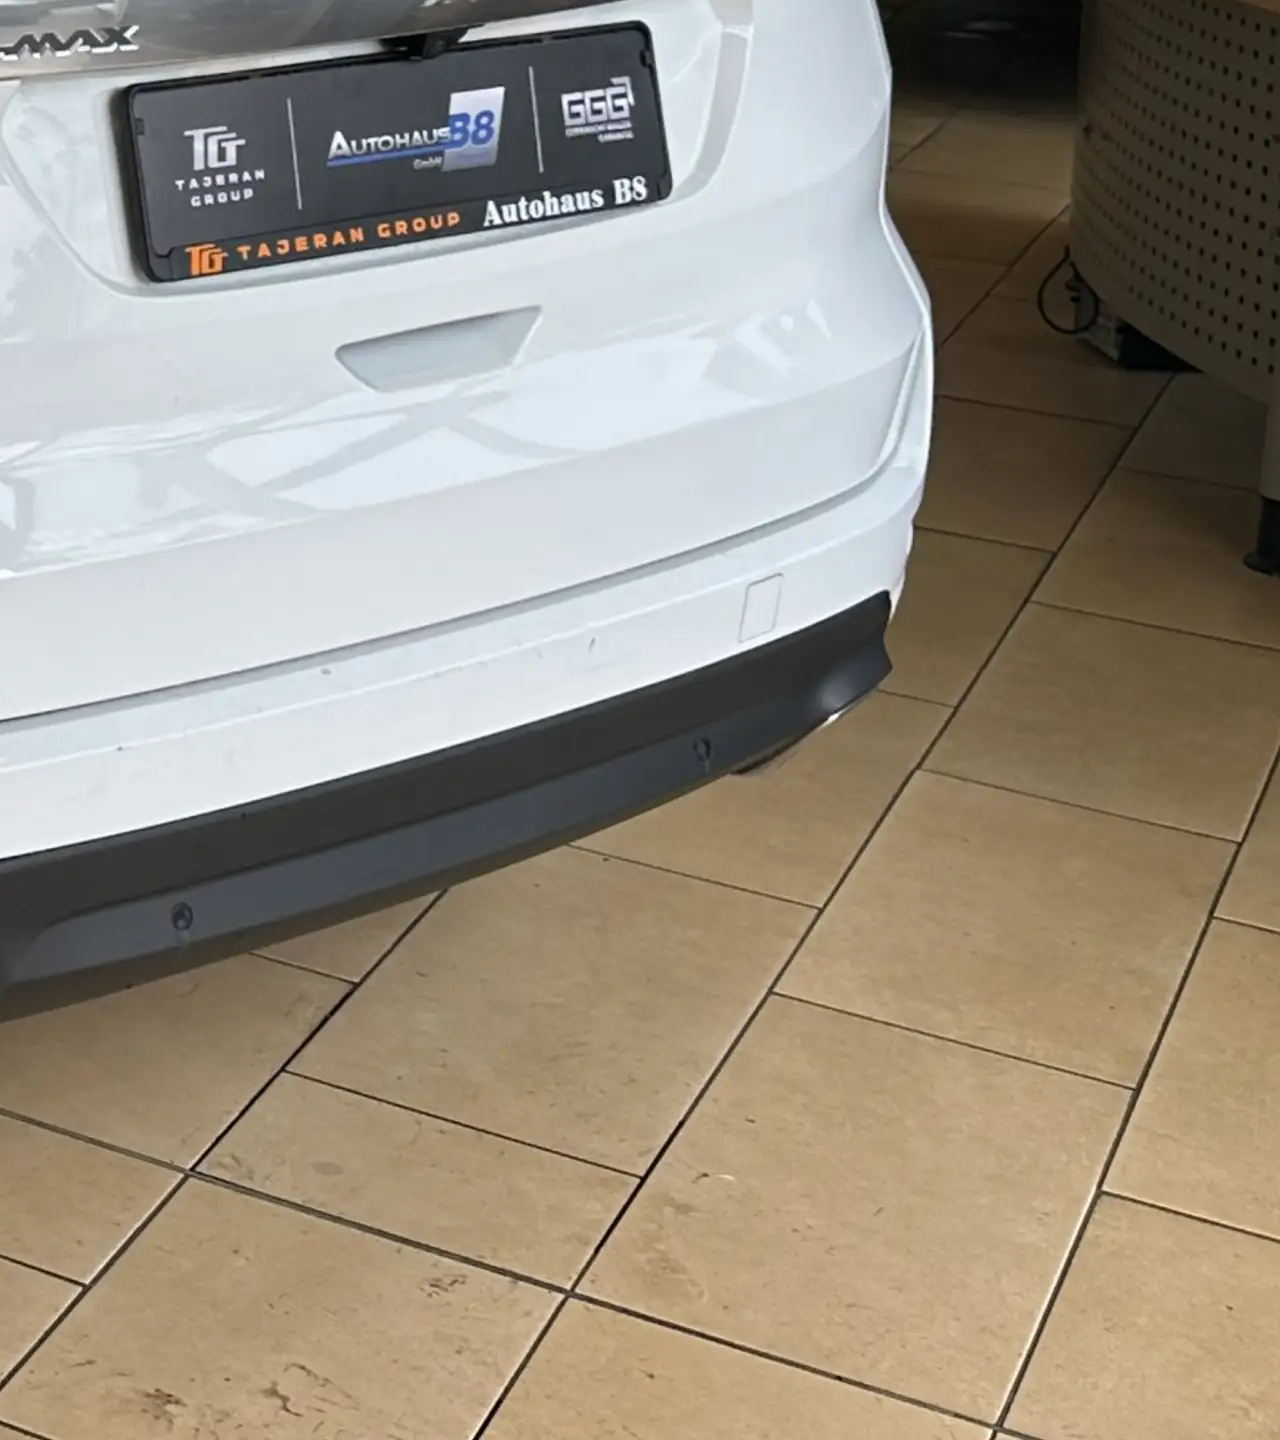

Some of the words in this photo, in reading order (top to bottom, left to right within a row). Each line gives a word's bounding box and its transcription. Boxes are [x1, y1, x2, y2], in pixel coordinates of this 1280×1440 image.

[175, 168, 266, 191] TAJERAN
[190, 188, 255, 208] GROUP
[483, 188, 604, 227] Autohaus
[612, 176, 648, 206] B8
[237, 227, 364, 261] TAJERAN
[376, 211, 461, 238] GROUP
